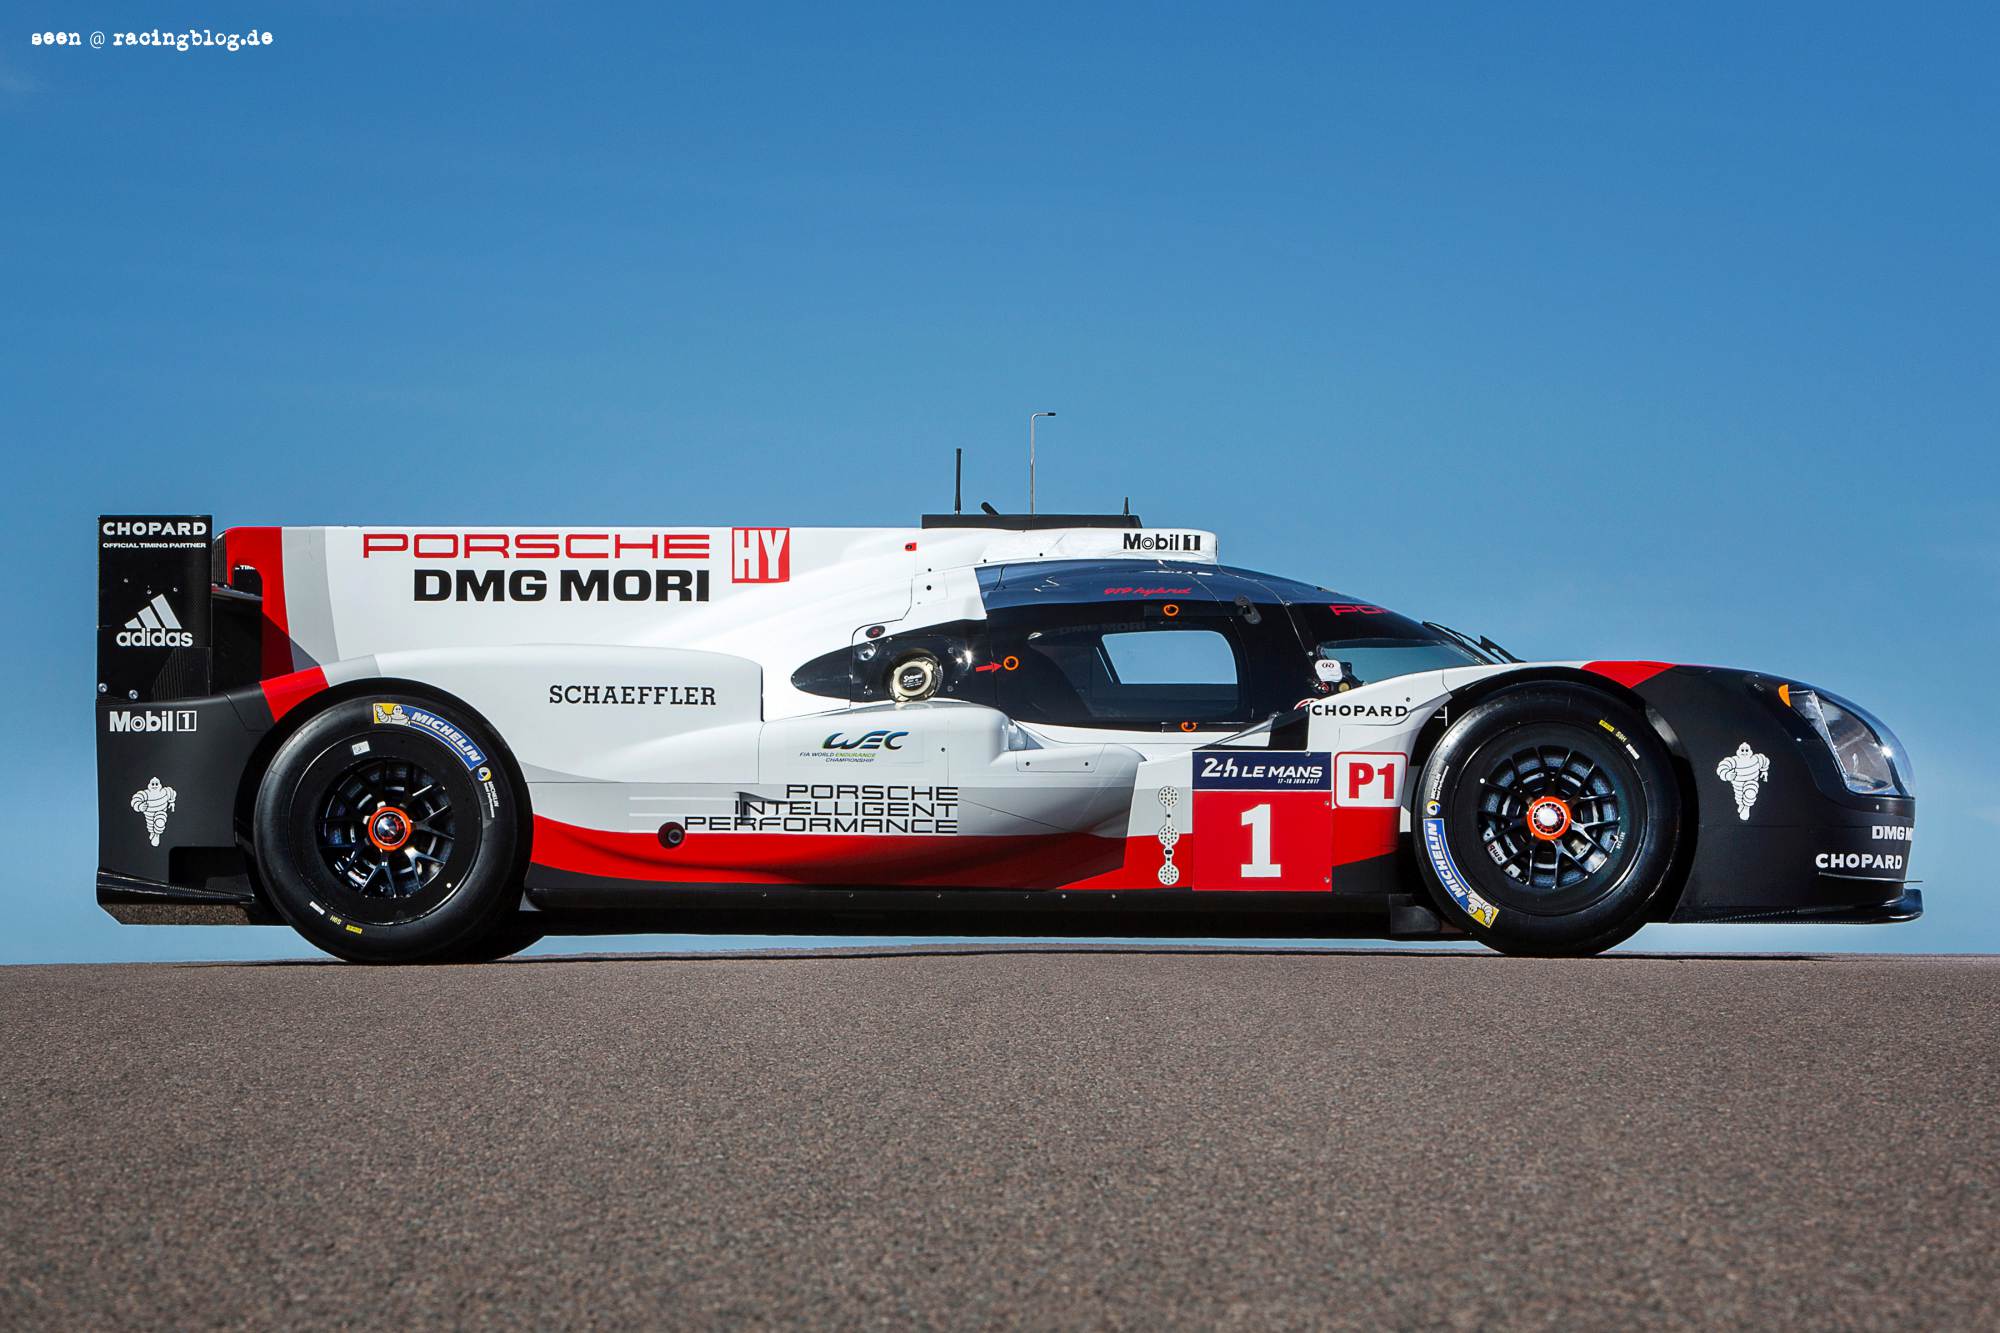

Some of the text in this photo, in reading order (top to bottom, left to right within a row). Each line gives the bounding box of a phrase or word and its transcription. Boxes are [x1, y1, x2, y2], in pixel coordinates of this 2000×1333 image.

[102, 521, 207, 536] CHOPARD
[363, 533, 710, 559] PORSCHE
[1123, 532, 1179, 551] Mobil
[733, 529, 789, 580] HY
[414, 568, 710, 602] DMG MORI
[115, 627, 194, 647] adidas
[549, 685, 716, 706] SCHAEFFLER
[109, 711, 174, 732] Mobil
[1311, 704, 1409, 718] CHOPARD
[411, 710, 481, 763] MICHELIN
[822, 729, 912, 751] WEC
[1200, 757, 1323, 778] 24h LE MANS
[1348, 762, 1396, 800] P1
[786, 784, 958, 801] PORSCHE
[735, 801, 958, 817] INTELLIGENT
[685, 816, 958, 834] PERFORMANCE
[1871, 825, 1905, 841] DMG
[1240, 803, 1282, 879] 1
[1425, 822, 1467, 900] MICHELIN
[1815, 853, 1903, 870] CHOPARD
